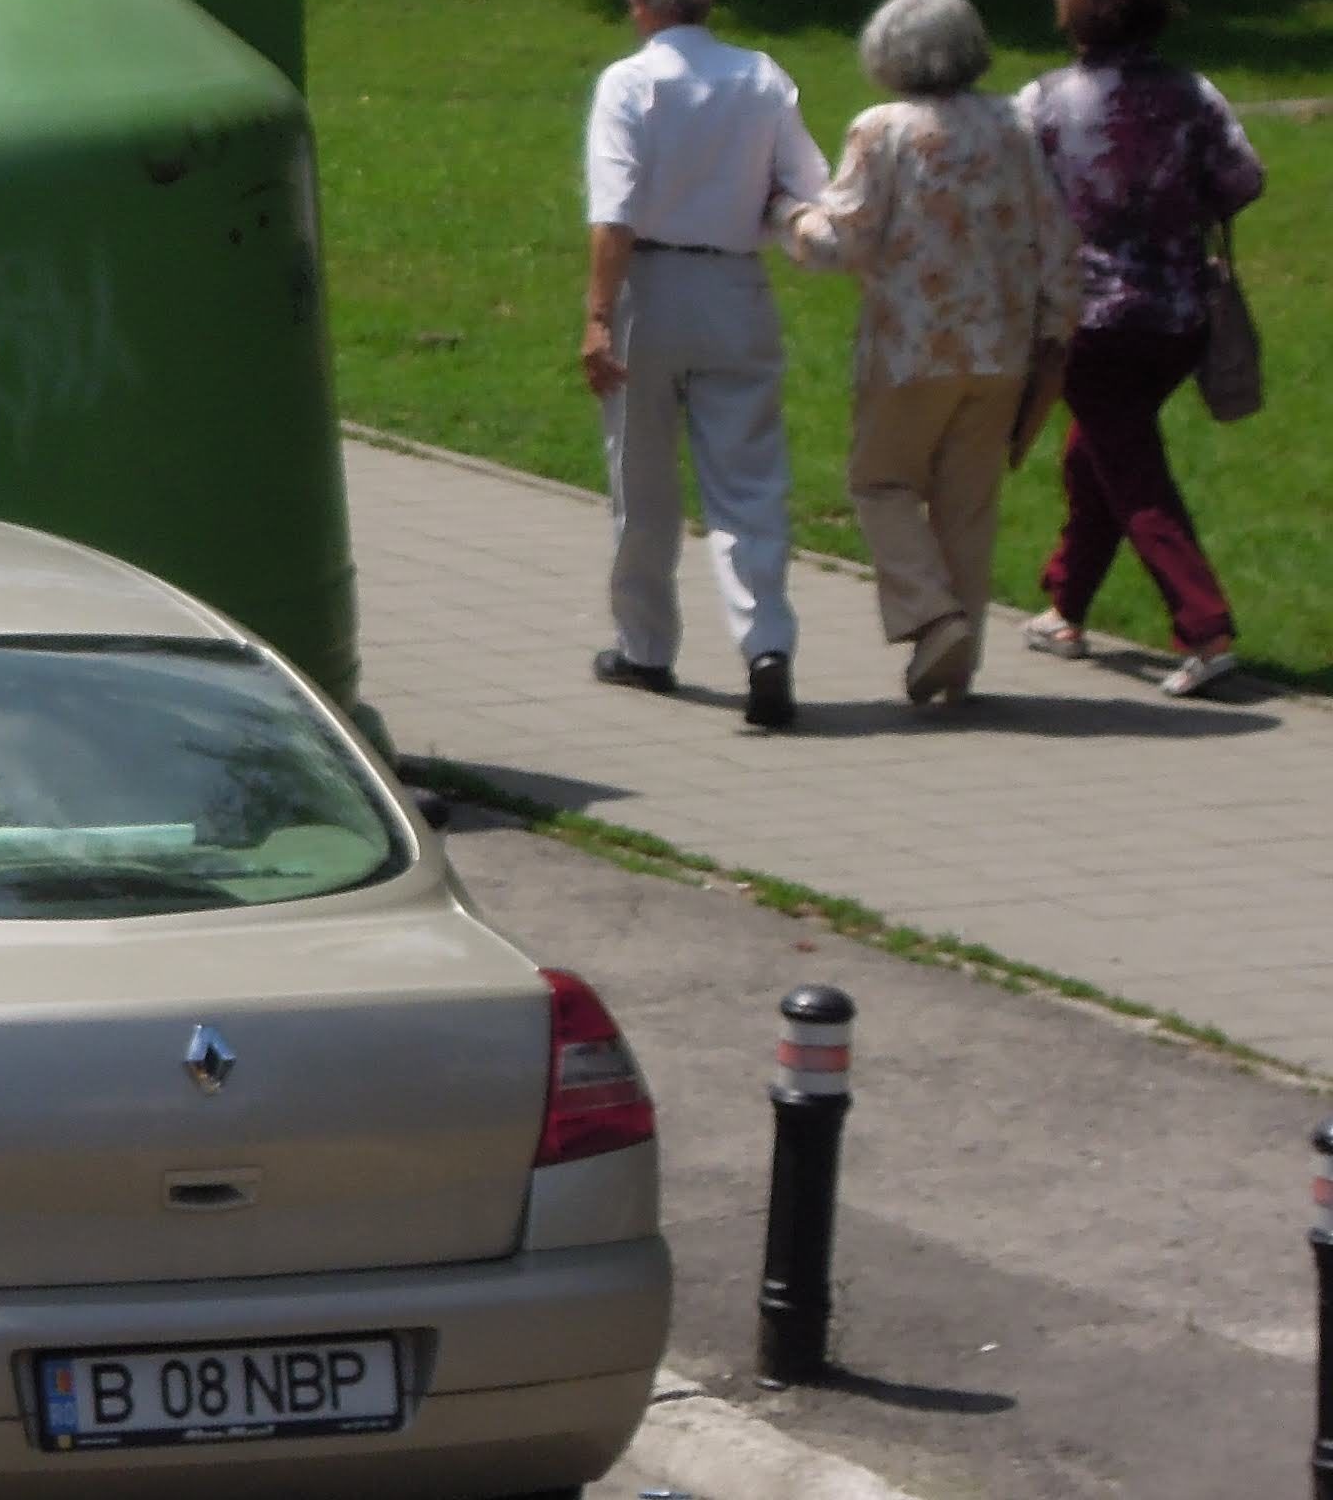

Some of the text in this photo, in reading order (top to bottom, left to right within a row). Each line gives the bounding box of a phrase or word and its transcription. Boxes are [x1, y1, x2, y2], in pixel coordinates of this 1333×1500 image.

[90, 1350, 366, 1425] B 08 NBP
